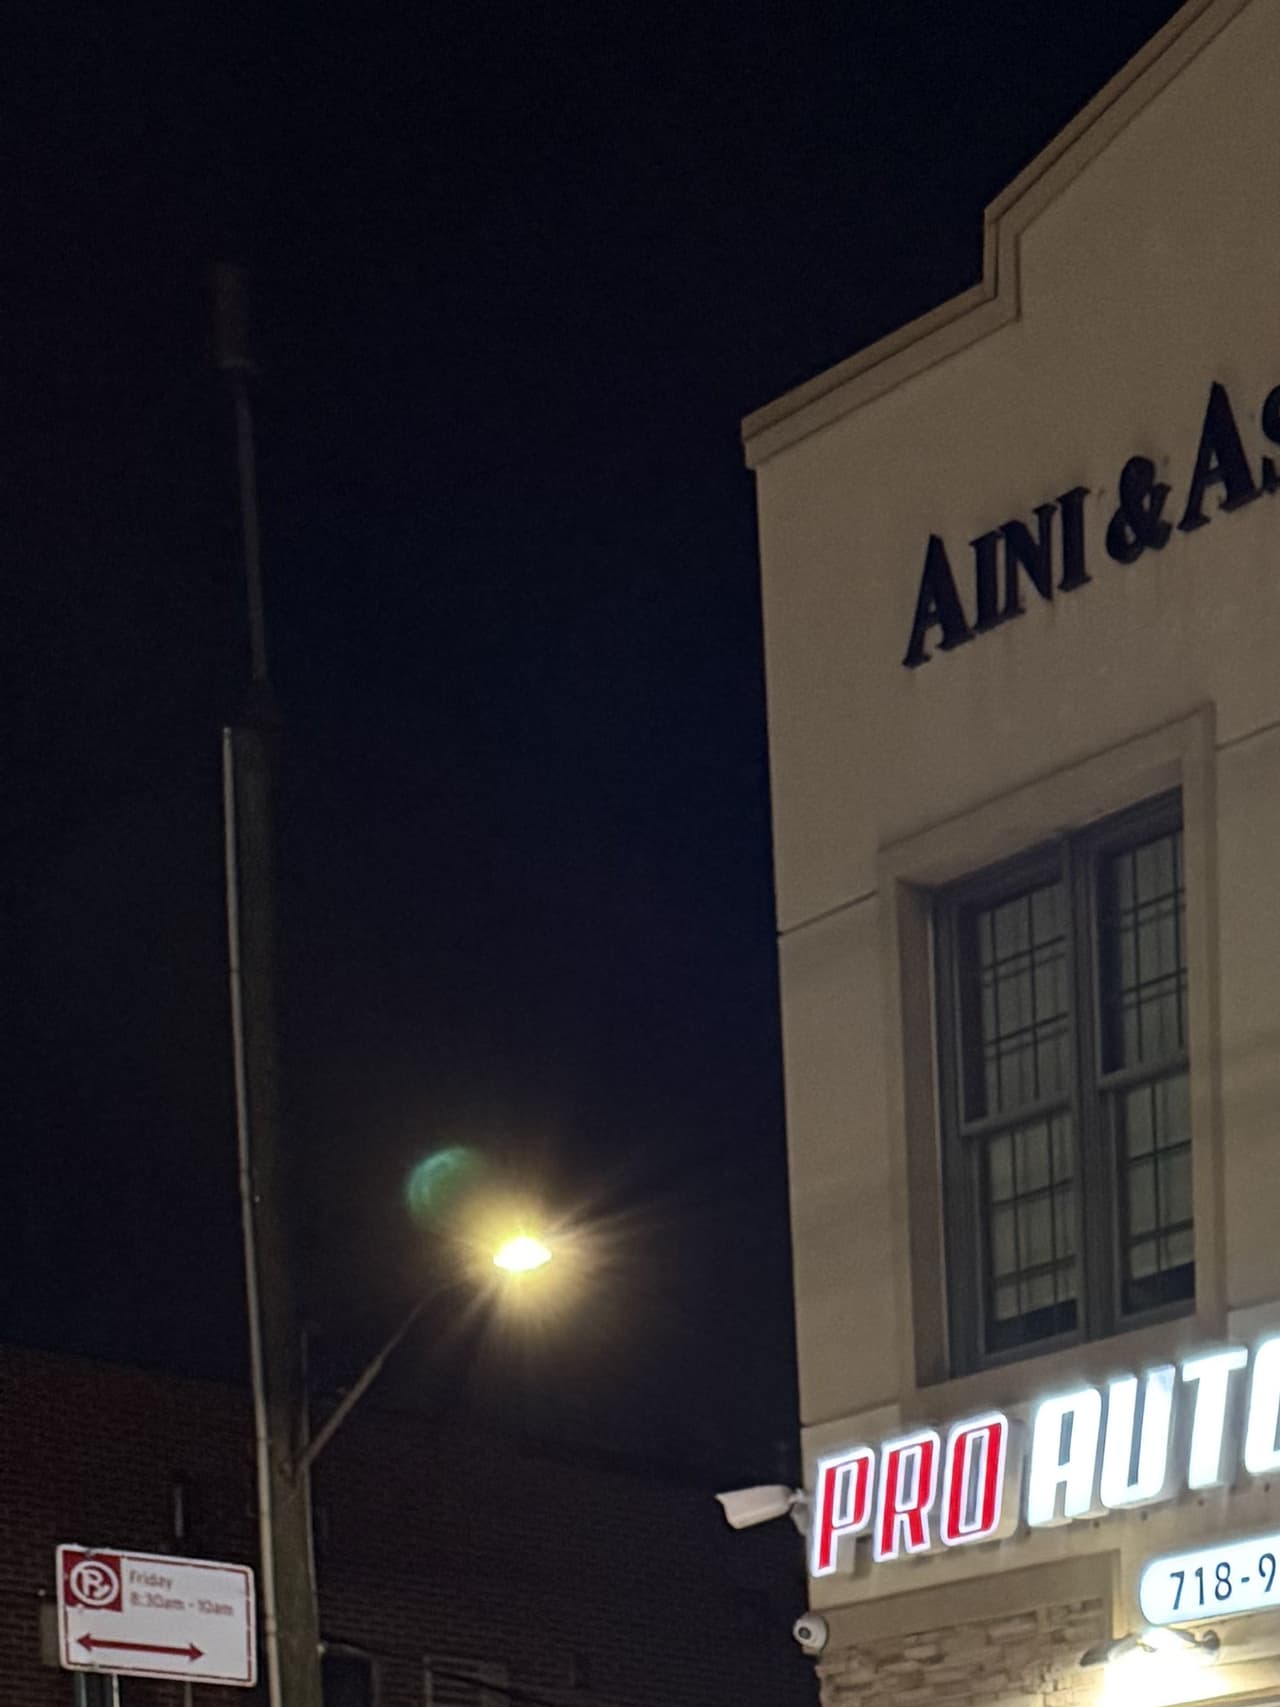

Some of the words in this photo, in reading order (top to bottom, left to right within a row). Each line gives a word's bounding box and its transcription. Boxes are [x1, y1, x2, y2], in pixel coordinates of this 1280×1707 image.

[902, 488, 1094, 669] AINI
[1106, 455, 1172, 566] &
[811, 1413, 1007, 1577] PRO
[130, 1569, 173, 1592] Friday
